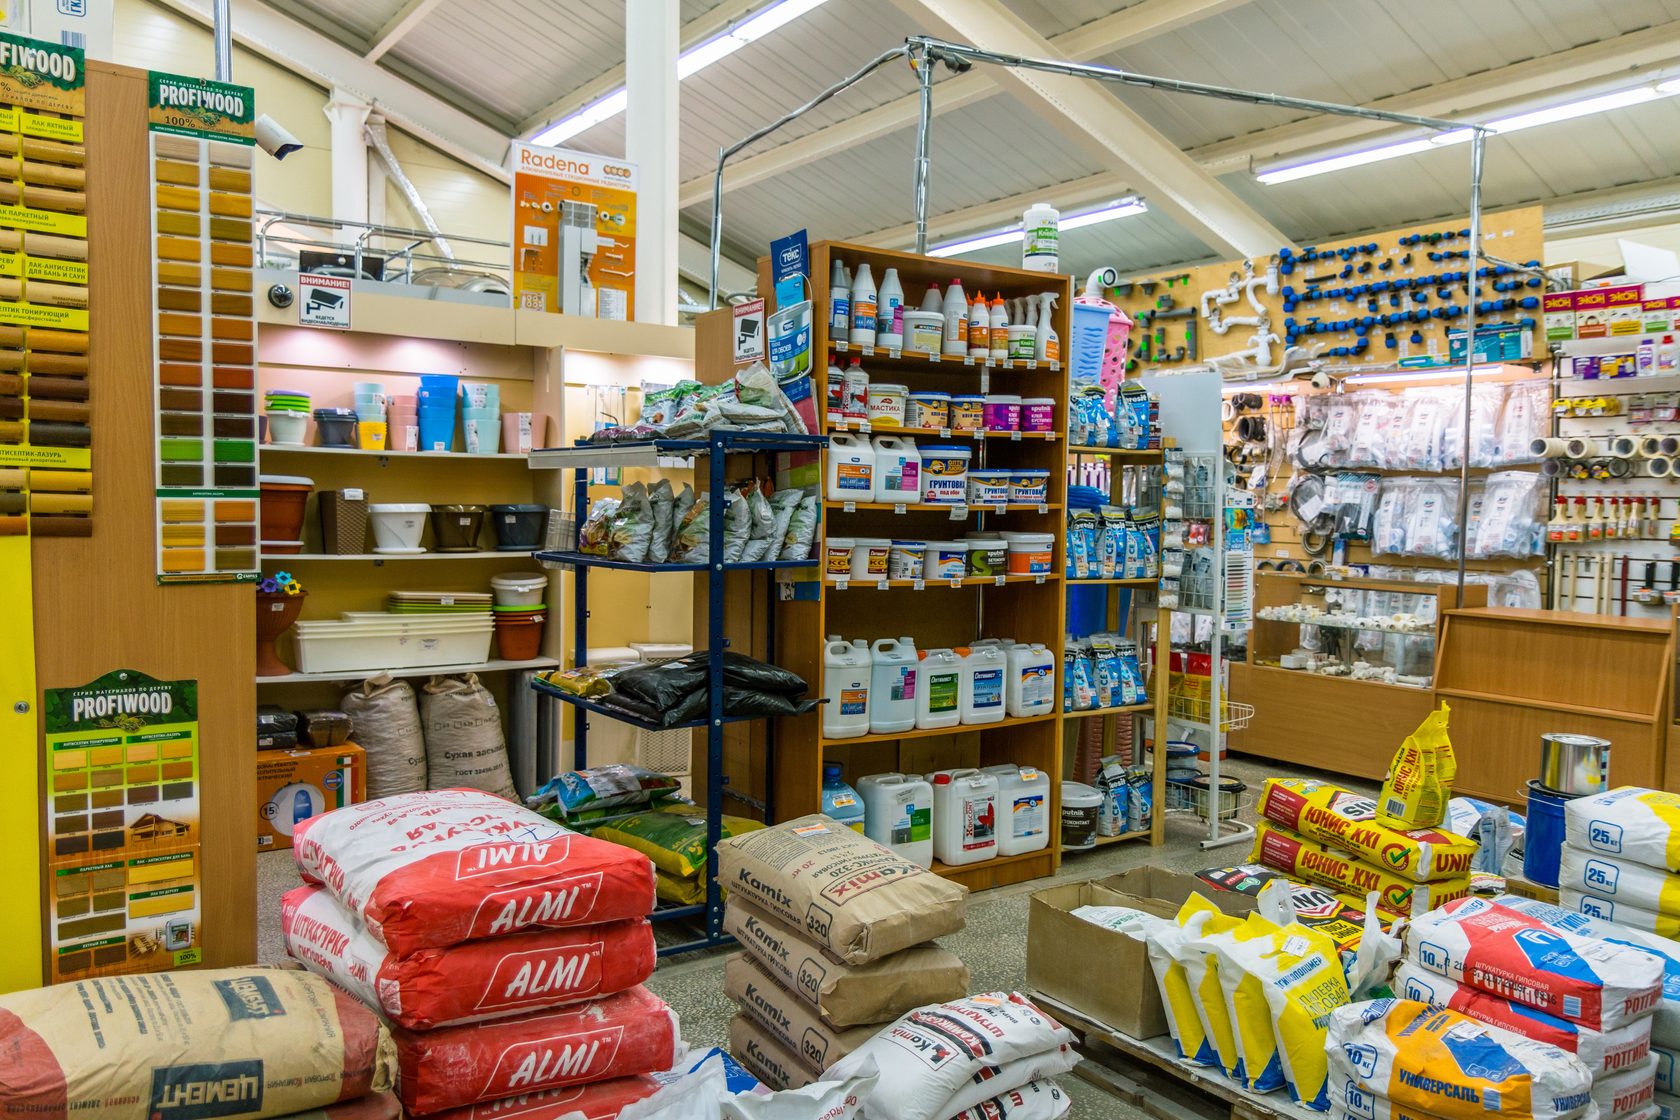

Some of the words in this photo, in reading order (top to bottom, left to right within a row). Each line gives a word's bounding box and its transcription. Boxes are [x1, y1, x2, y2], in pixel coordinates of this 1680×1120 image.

[159, 84, 244, 118] PROFIWOOD
[165, 115, 196, 128] 100%
[521, 149, 590, 176] Radena
[300, 276, 350, 288] ВНИМАНИЕ!
[1545, 296, 1572, 309] ЭКОН
[1576, 293, 1605, 305] ЭКОН
[1609, 290, 1638, 302] ЭКОН
[870, 404, 901, 412] МАСТИКА
[73, 692, 172, 722] PROFIWOOD
[444, 751, 473, 760] Сухая
[1304, 806, 1351, 831] ЮНИС
[1350, 827, 1381, 850] XXI
[1592, 828, 1610, 845] 25
[478, 842, 551, 869] ALMI
[1301, 850, 1349, 880] ЮНИС
[1350, 867, 1381, 892] XXI
[1588, 867, 1606, 885] 25
[739, 867, 792, 909] Kamix
[490, 886, 579, 934] ALMI
[1583, 903, 1600, 918] 25
[293, 913, 350, 959] ШТУКАТУРКА
[745, 916, 790, 961] Kamix
[808, 915, 828, 938] 320
[180, 952, 197, 961] 100%
[1422, 950, 1435, 966] 10
[504, 952, 590, 998] ALMI
[800, 969, 818, 993] 320
[1475, 961, 1514, 979] ШТУКАТУРКА
[1515, 975, 1550, 991] ГИПСОВАЯ
[745, 983, 792, 1031] Kamix
[1458, 1004, 1494, 1024] ШКАТУРКА
[1494, 1018, 1527, 1036] ГИПСОВАЯ
[803, 1039, 822, 1065] 320
[891, 1027, 928, 1051] Kamix
[508, 1039, 599, 1088] ALMI
[747, 1039, 791, 1086] Kamix
[155, 1074, 259, 1109] ЦЕМЕНТ
[1348, 1091, 1362, 1108] 10
[1400, 1069, 1480, 1104] УНИВЕРСАЛЬ
